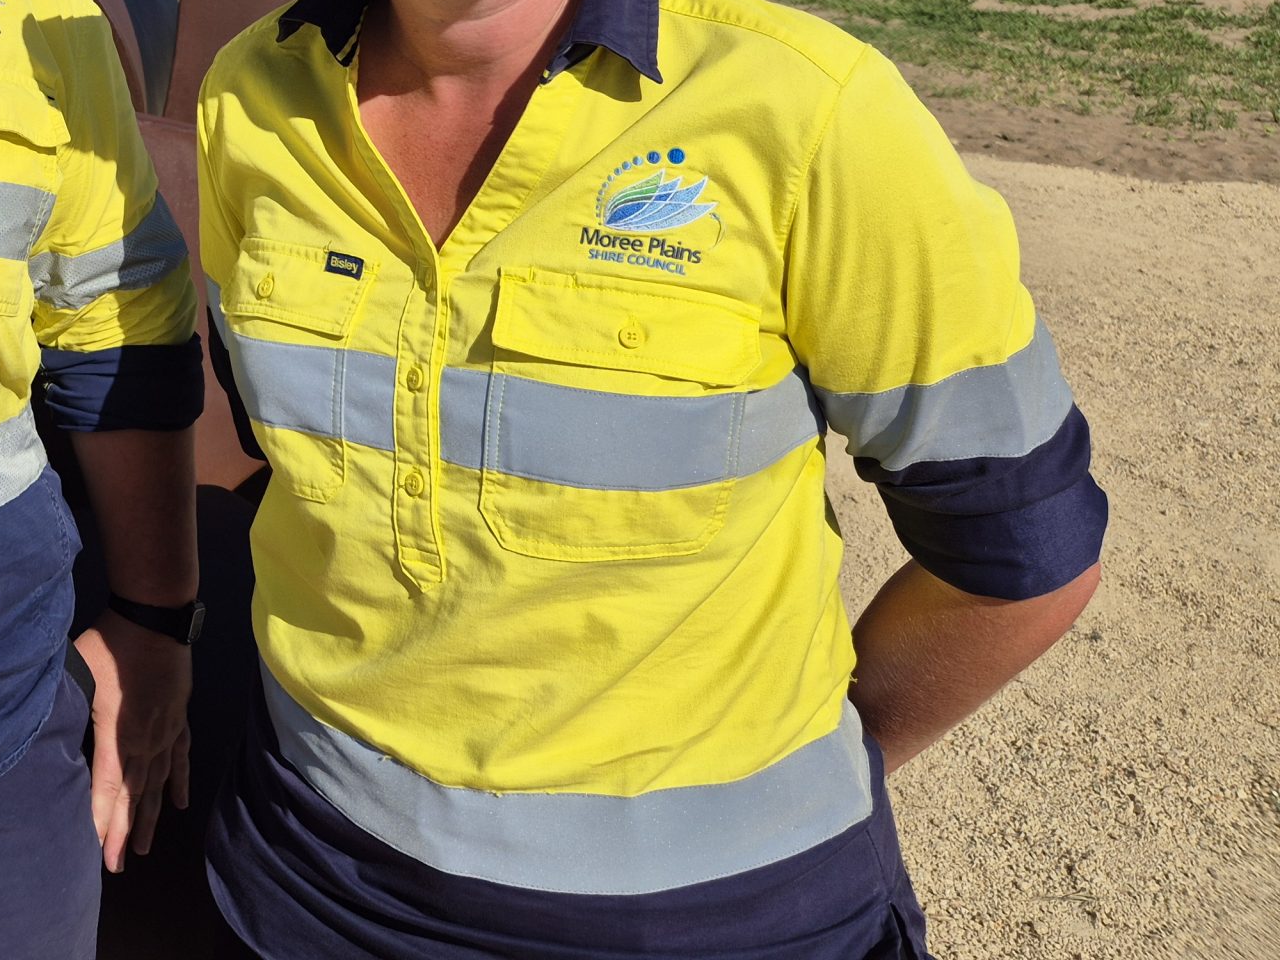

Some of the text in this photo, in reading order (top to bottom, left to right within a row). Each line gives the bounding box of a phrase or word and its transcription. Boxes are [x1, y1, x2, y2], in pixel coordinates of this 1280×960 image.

[579, 227, 702, 264] Moree Plains
[331, 255, 359, 274] Bisley
[588, 248, 686, 275] SHIRE COUNCIL
